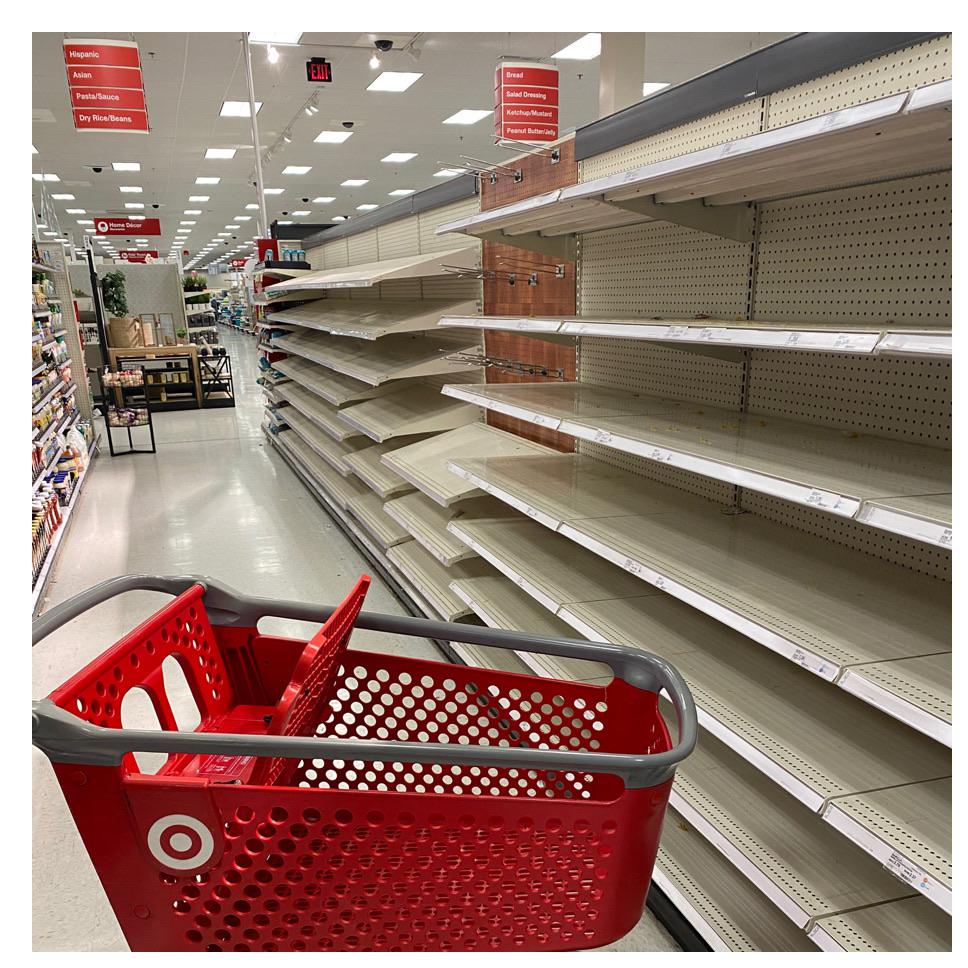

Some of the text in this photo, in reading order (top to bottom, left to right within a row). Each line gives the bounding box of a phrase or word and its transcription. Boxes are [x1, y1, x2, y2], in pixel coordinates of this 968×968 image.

[69, 50, 100, 59] Hispanic
[73, 71, 92, 79] Asian
[311, 63, 329, 80] EXIT
[506, 71, 524, 79] Bread
[76, 92, 120, 101] Pasta/Sauce
[523, 91, 547, 100] Dressing
[506, 109, 552, 118] Ketchup/Mustard
[79, 114, 132, 123] Dry Rice/Beans
[527, 128, 556, 136] Butter/Jelly
